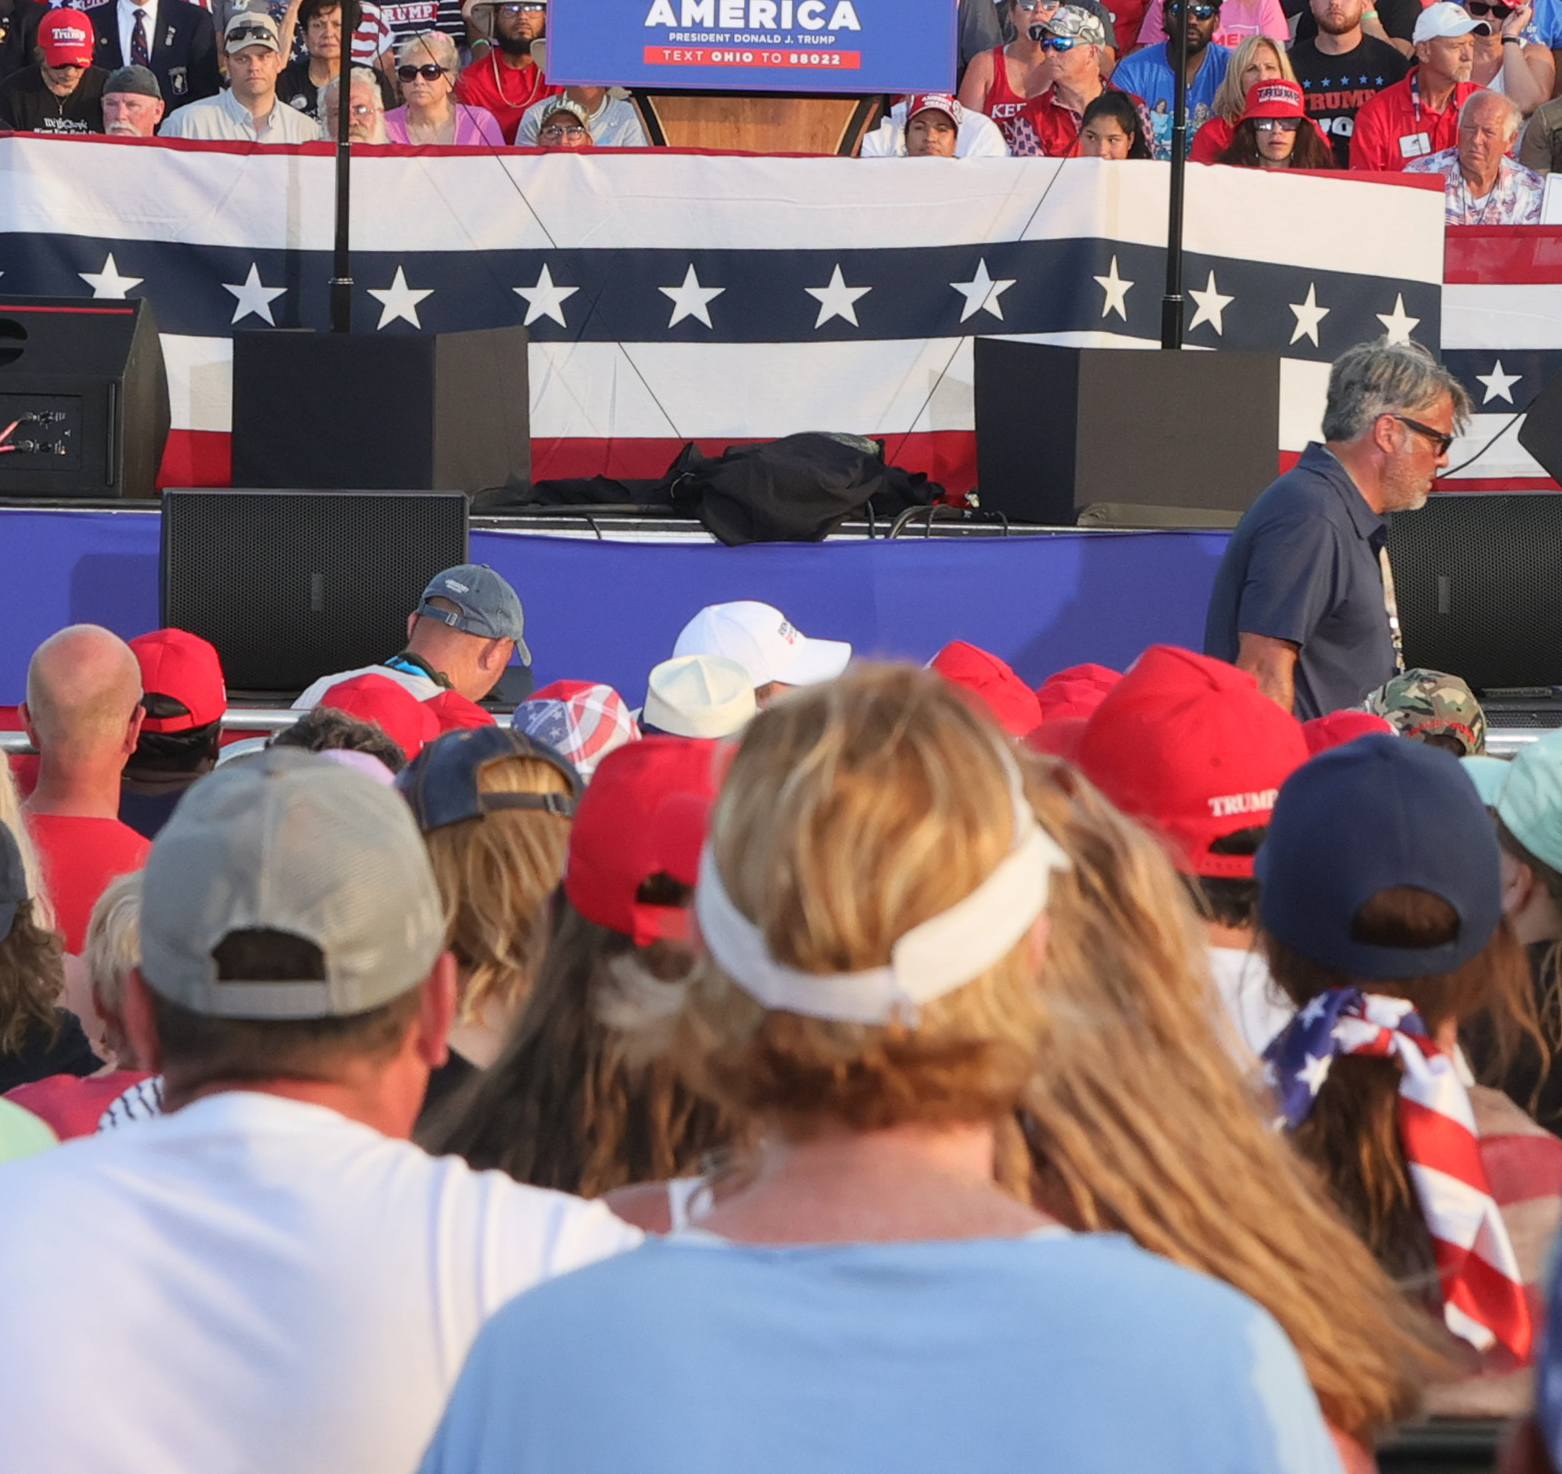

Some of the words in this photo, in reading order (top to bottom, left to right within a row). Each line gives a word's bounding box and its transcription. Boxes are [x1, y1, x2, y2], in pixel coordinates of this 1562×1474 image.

[52, 28, 86, 41] Trump
[669, 33, 731, 44] PRESIDENT
[734, 33, 782, 44] DONALD
[784, 34, 794, 44] J.
[798, 34, 836, 45] TRUMP
[663, 49, 704, 61] TEXT
[711, 51, 753, 63] OHIO
[762, 53, 783, 63] TO
[790, 53, 841, 65] 88022
[1305, 88, 1378, 112] TRUMP
